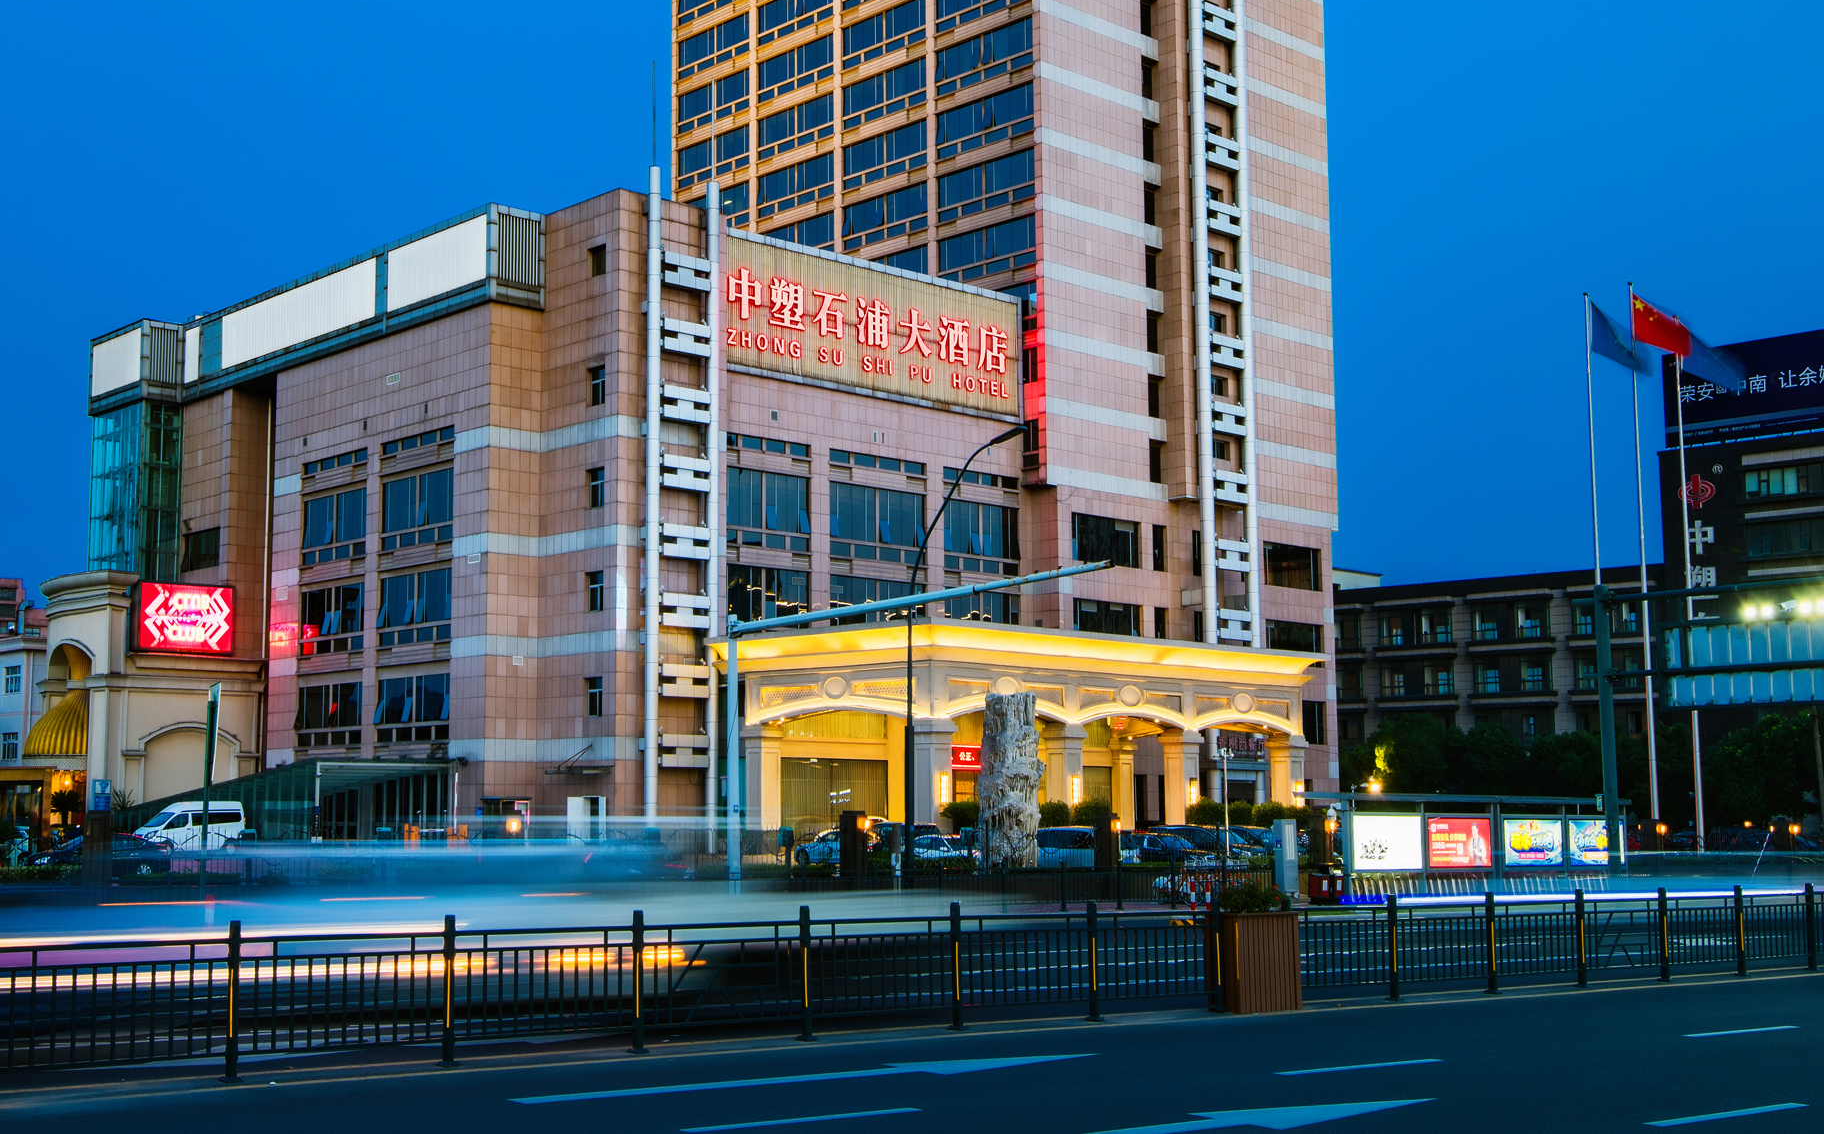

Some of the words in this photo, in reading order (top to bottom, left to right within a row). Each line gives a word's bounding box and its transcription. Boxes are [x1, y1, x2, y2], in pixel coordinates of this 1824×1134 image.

[728, 267, 1009, 374] 中塑石浦大酒店
[727, 328, 802, 359] ZHONG
[818, 346, 845, 366] SU
[863, 356, 894, 376] SHI
[910, 364, 933, 384] PU
[952, 372, 1010, 399] HOTEL
[167, 625, 206, 643] CLUB
